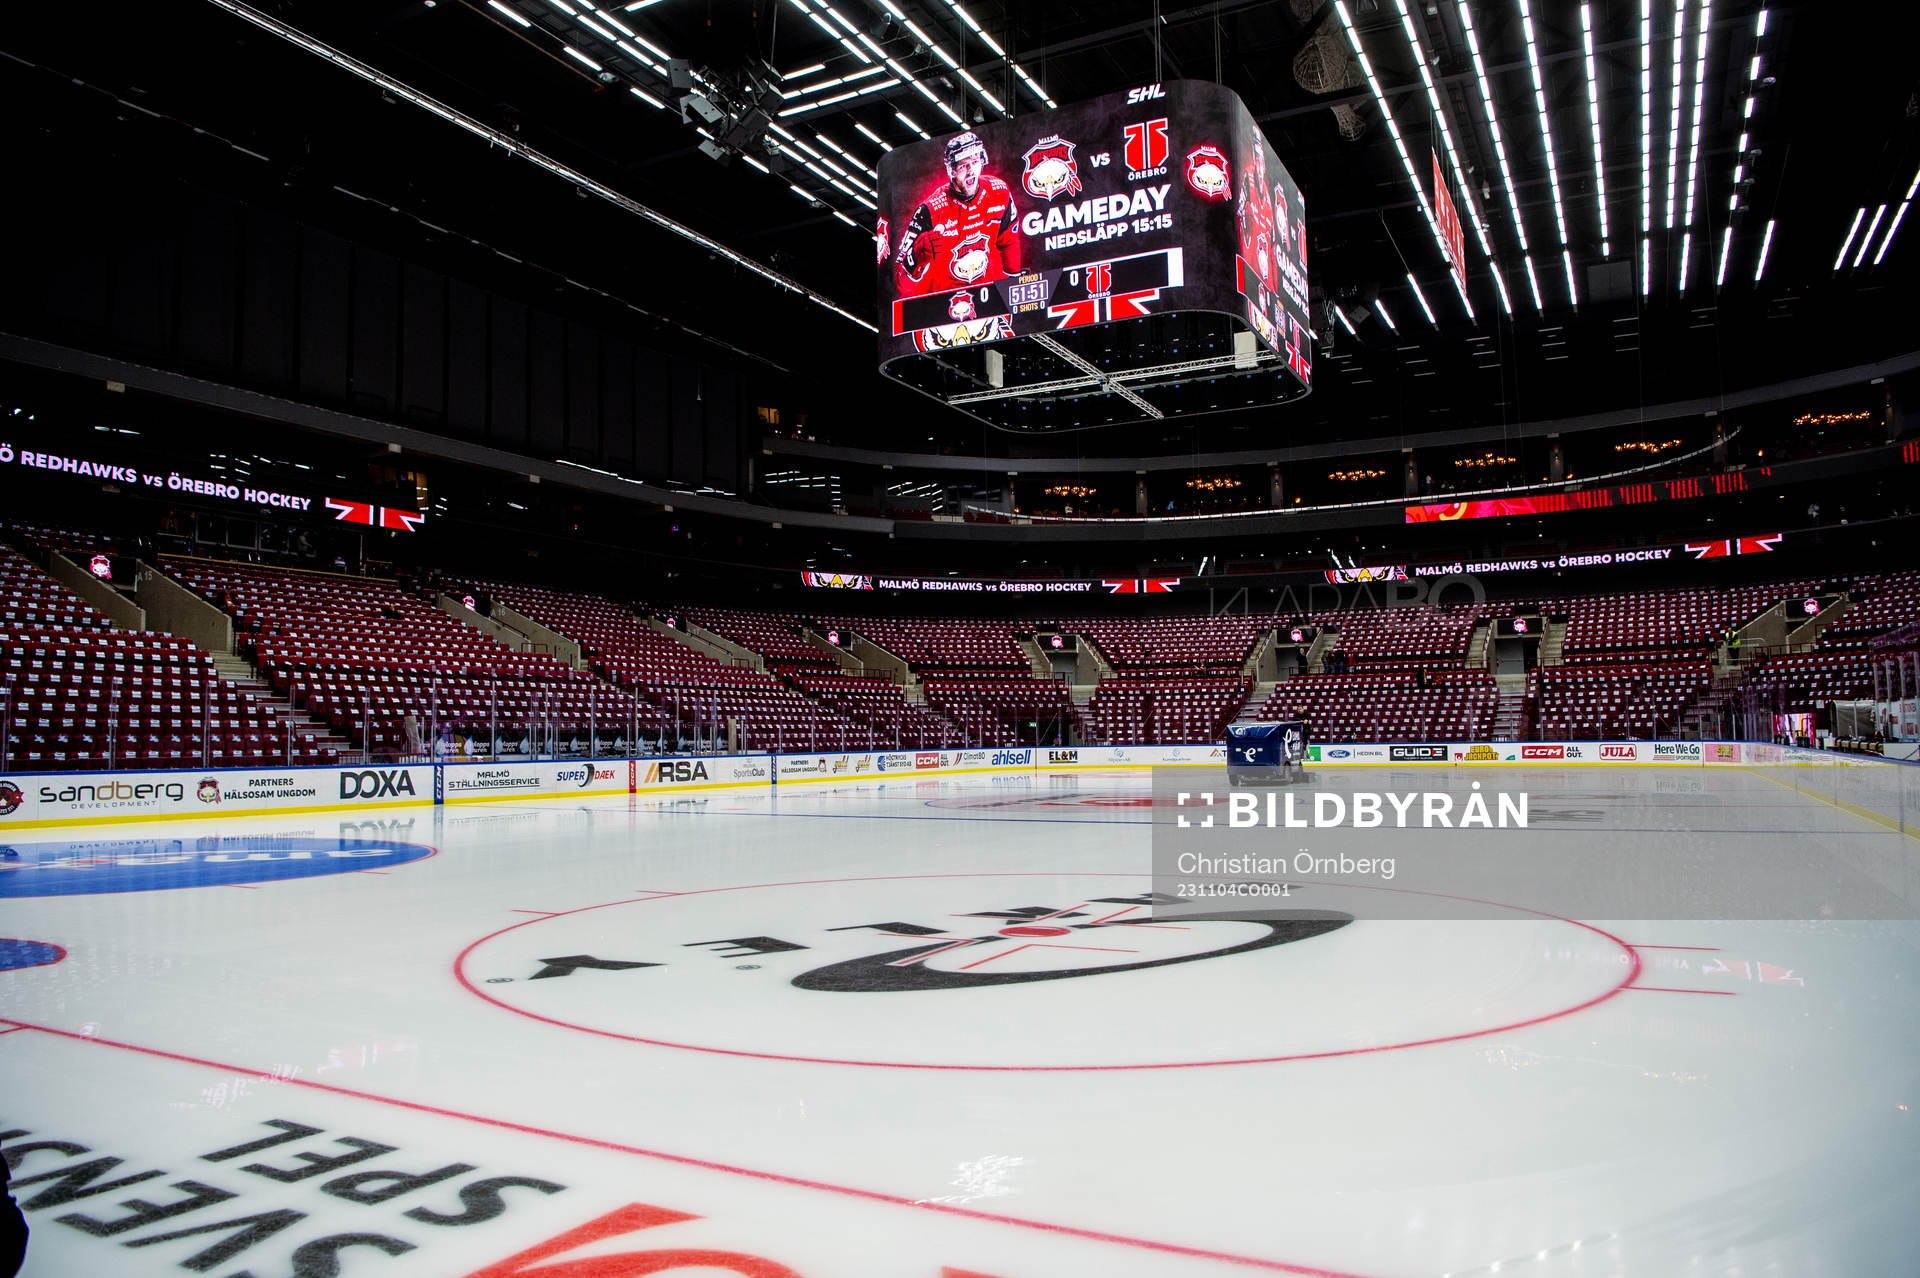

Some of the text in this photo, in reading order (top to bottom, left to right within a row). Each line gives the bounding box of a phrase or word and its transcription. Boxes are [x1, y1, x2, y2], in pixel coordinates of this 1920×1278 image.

[1126, 84, 1166, 104] SHL
[1128, 166, 1168, 182] ÖREBRO
[1021, 183, 1172, 236] GAMEDAY
[1045, 213, 1173, 251] NEDSLÄPP 15:15
[1018, 274, 1039, 285] PERIOD
[1069, 270, 1079, 287] 0
[980, 287, 989, 303] 0
[1011, 282, 1046, 303] 51:51
[1020, 303, 1038, 312] SHOTS
[20, 450, 137, 483] REDHAWKS
[167, 472, 240, 499] ÖREBRO
[244, 488, 311, 511] HOCKEY
[1415, 562, 1463, 576] MALMÖ
[1466, 560, 1538, 574] REDHAWKS
[1558, 554, 1612, 568] ÖREBRO
[1615, 548, 1672, 563] HOCKEY
[879, 578, 919, 590] MALMÖ
[922, 581, 983, 591] REDHAWKS
[999, 581, 1043, 592] ÖREBRO
[1046, 583, 1092, 592] HOCKEY
[1049, 751, 1078, 761] EL&M
[1393, 748, 1443, 757] GUIDE
[1524, 748, 1563, 756] CCM
[1601, 746, 1635, 757] JULA
[1654, 744, 1675, 754] Here
[1675, 744, 1688, 754] We
[1689, 744, 1700, 754] Go
[917, 755, 938, 765] CCM
[991, 749, 1032, 766] ahlsell
[477, 770, 510, 778] MALMÖ
[556, 770, 585, 782] SUPER
[658, 761, 709, 783] RSA
[248, 778, 294, 787] PARTNERS
[340, 769, 416, 799] DOXA
[448, 778, 540, 789] STÄLLNINGSSERVICE
[40, 781, 184, 803] sandberg
[224, 789, 316, 800] HÄLSOSAM UNGDOM
[71, 801, 157, 809] DEVELOPMENT
[198, 1118, 569, 1227] SPEL
